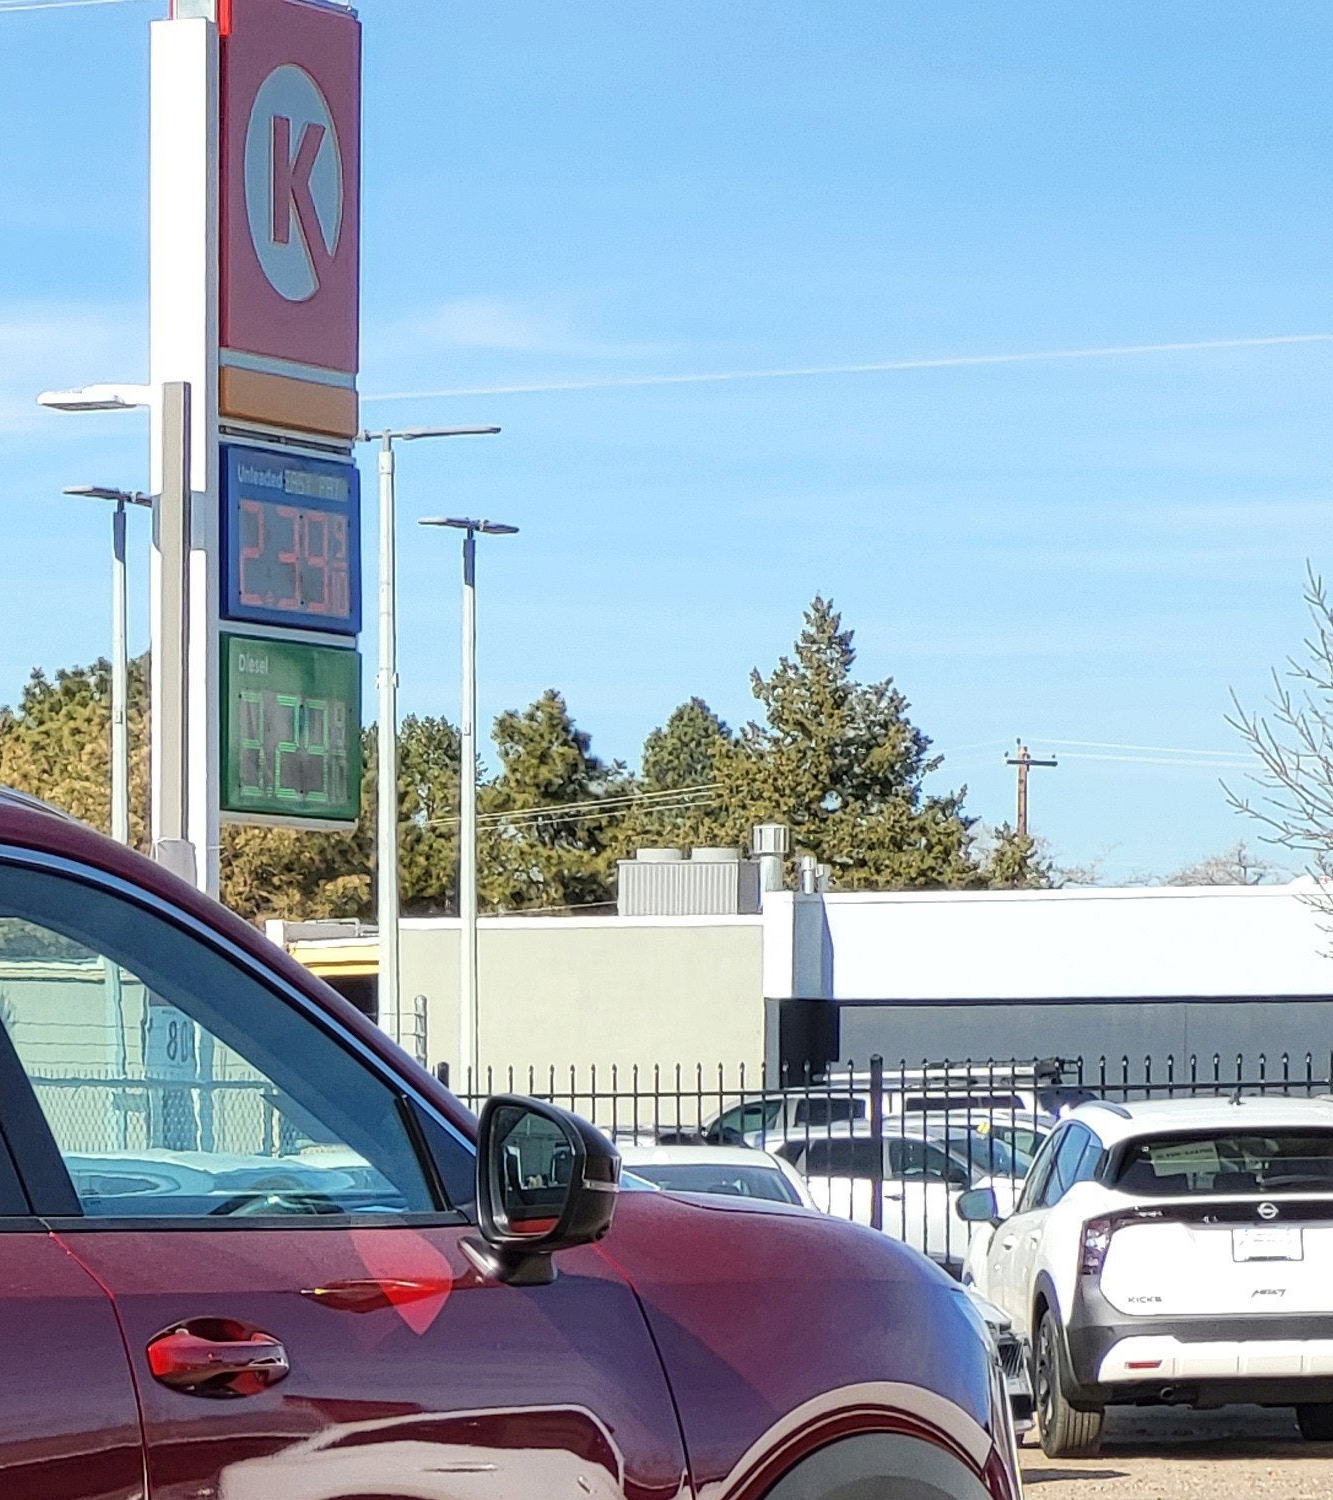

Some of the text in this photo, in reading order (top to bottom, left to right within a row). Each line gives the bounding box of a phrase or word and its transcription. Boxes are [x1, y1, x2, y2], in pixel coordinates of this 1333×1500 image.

[237, 463, 283, 489] Unleaded
[238, 653, 269, 675] Diesel
[1128, 1296, 1162, 1304] KICKS
